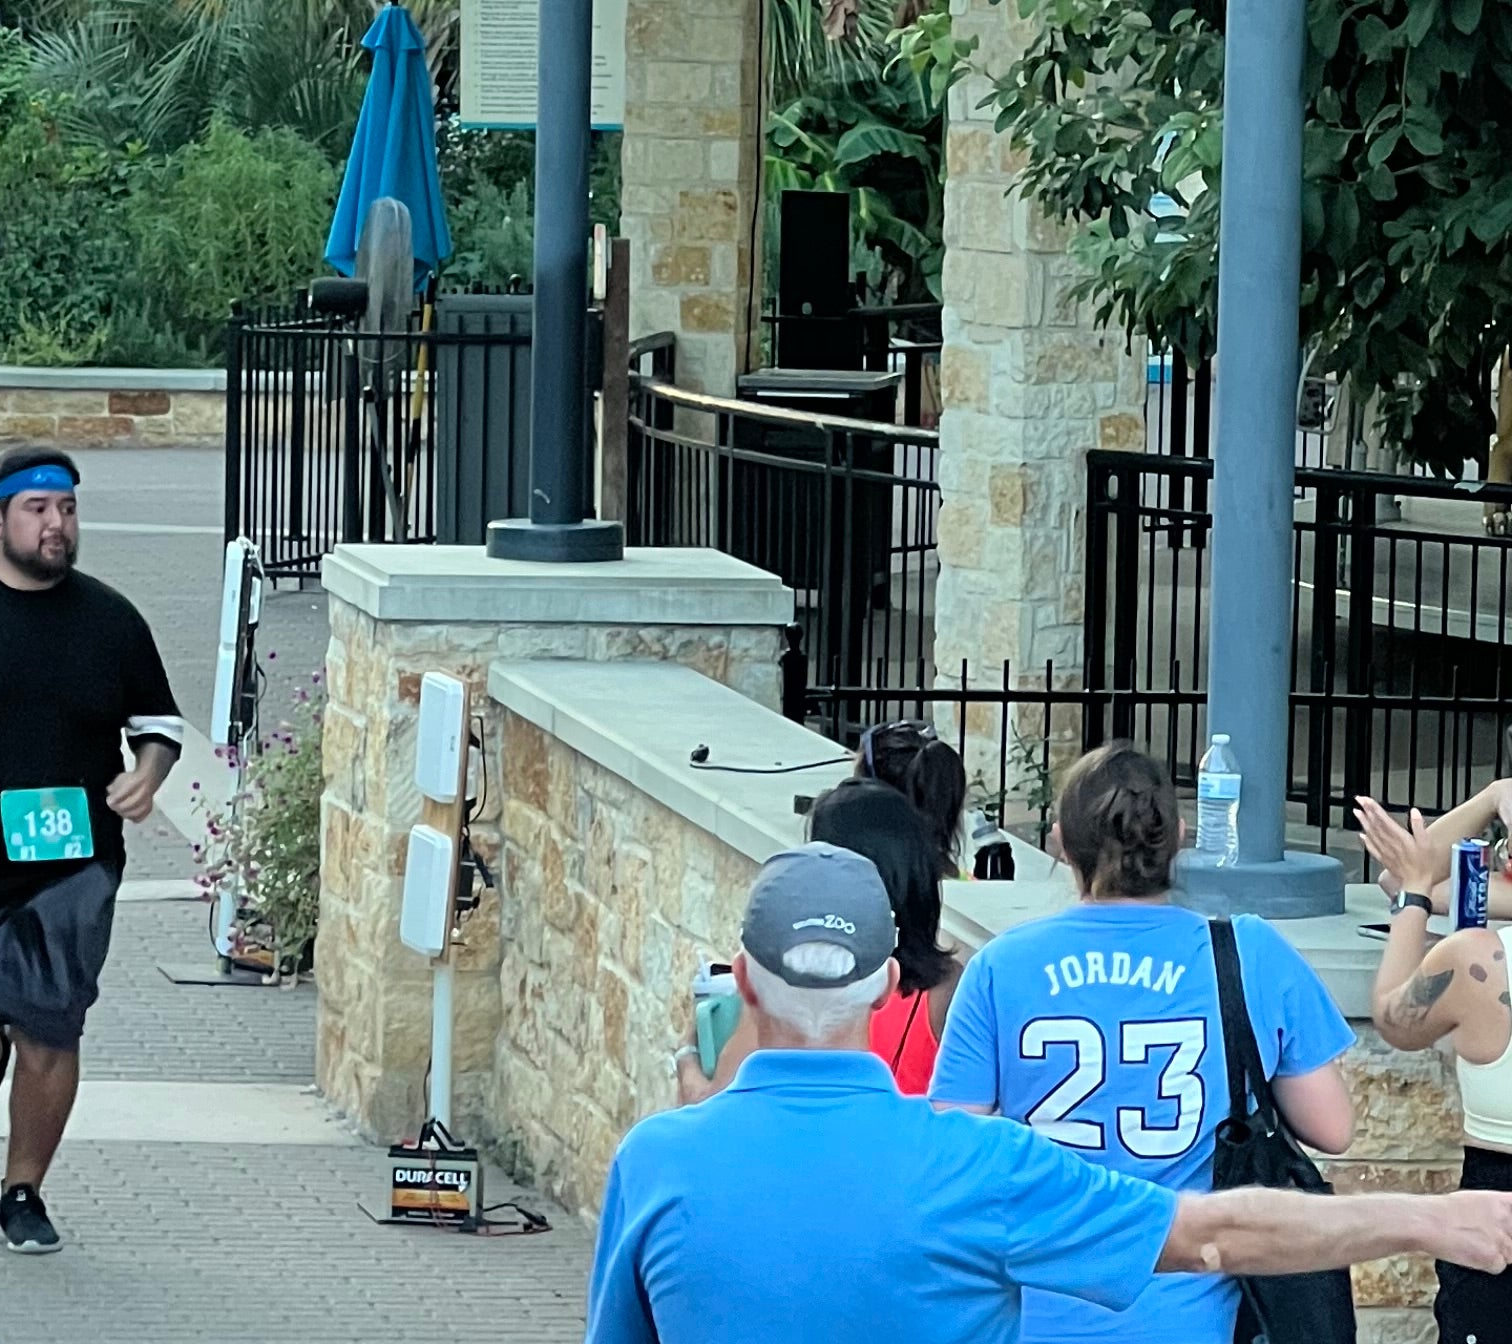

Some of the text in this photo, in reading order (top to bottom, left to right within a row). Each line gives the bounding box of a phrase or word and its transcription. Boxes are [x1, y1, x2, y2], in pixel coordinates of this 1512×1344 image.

[23, 807, 74, 838] 138
[1043, 950, 1187, 997] JORDAN
[1018, 1015, 1208, 1160] 23
